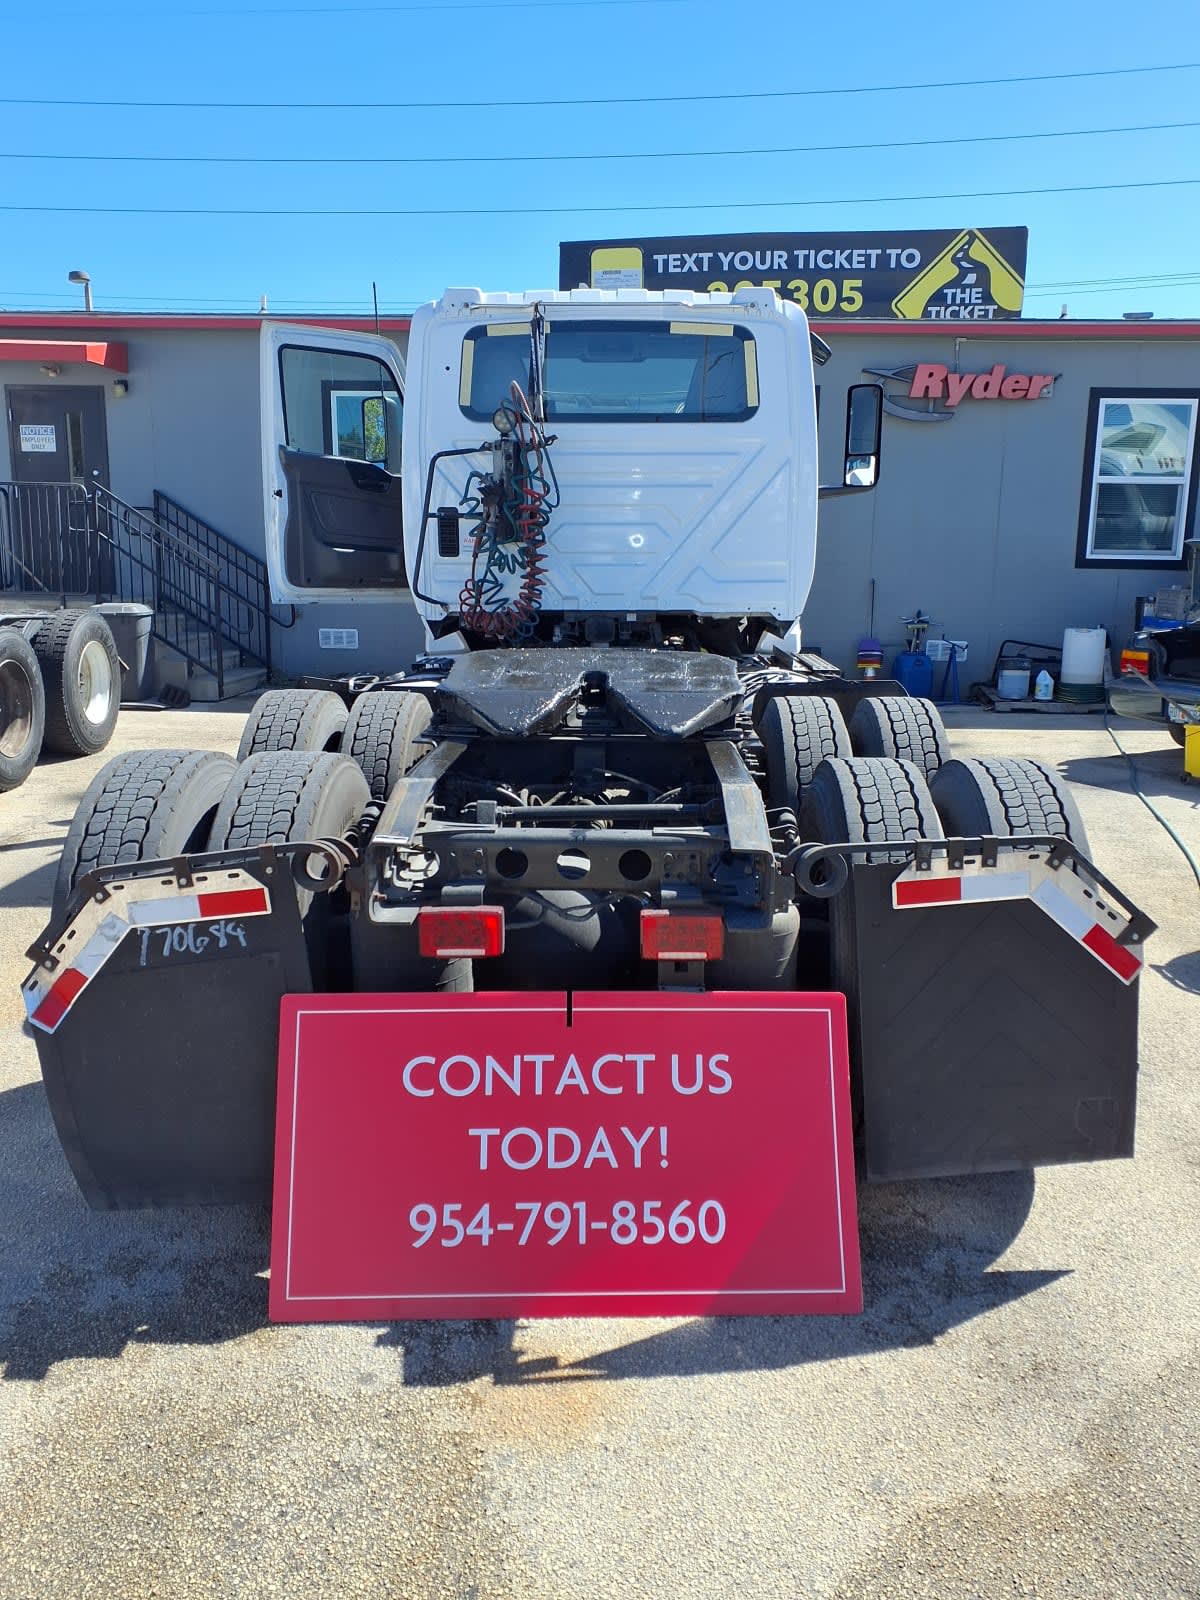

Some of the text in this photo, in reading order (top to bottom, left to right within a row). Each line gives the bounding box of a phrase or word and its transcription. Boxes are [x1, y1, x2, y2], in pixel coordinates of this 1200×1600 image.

[653, 247, 921, 274] TEXT YOUR TICKET TO
[927, 304, 998, 319] TICKET
[943, 287, 983, 305] THE
[909, 363, 1056, 407] Ryder
[22, 427, 54, 435] NOTICE
[402, 1053, 733, 1097] CONTACT US
[468, 1126, 670, 1170] TODAY!
[408, 1199, 727, 1249] 954-791-8560
